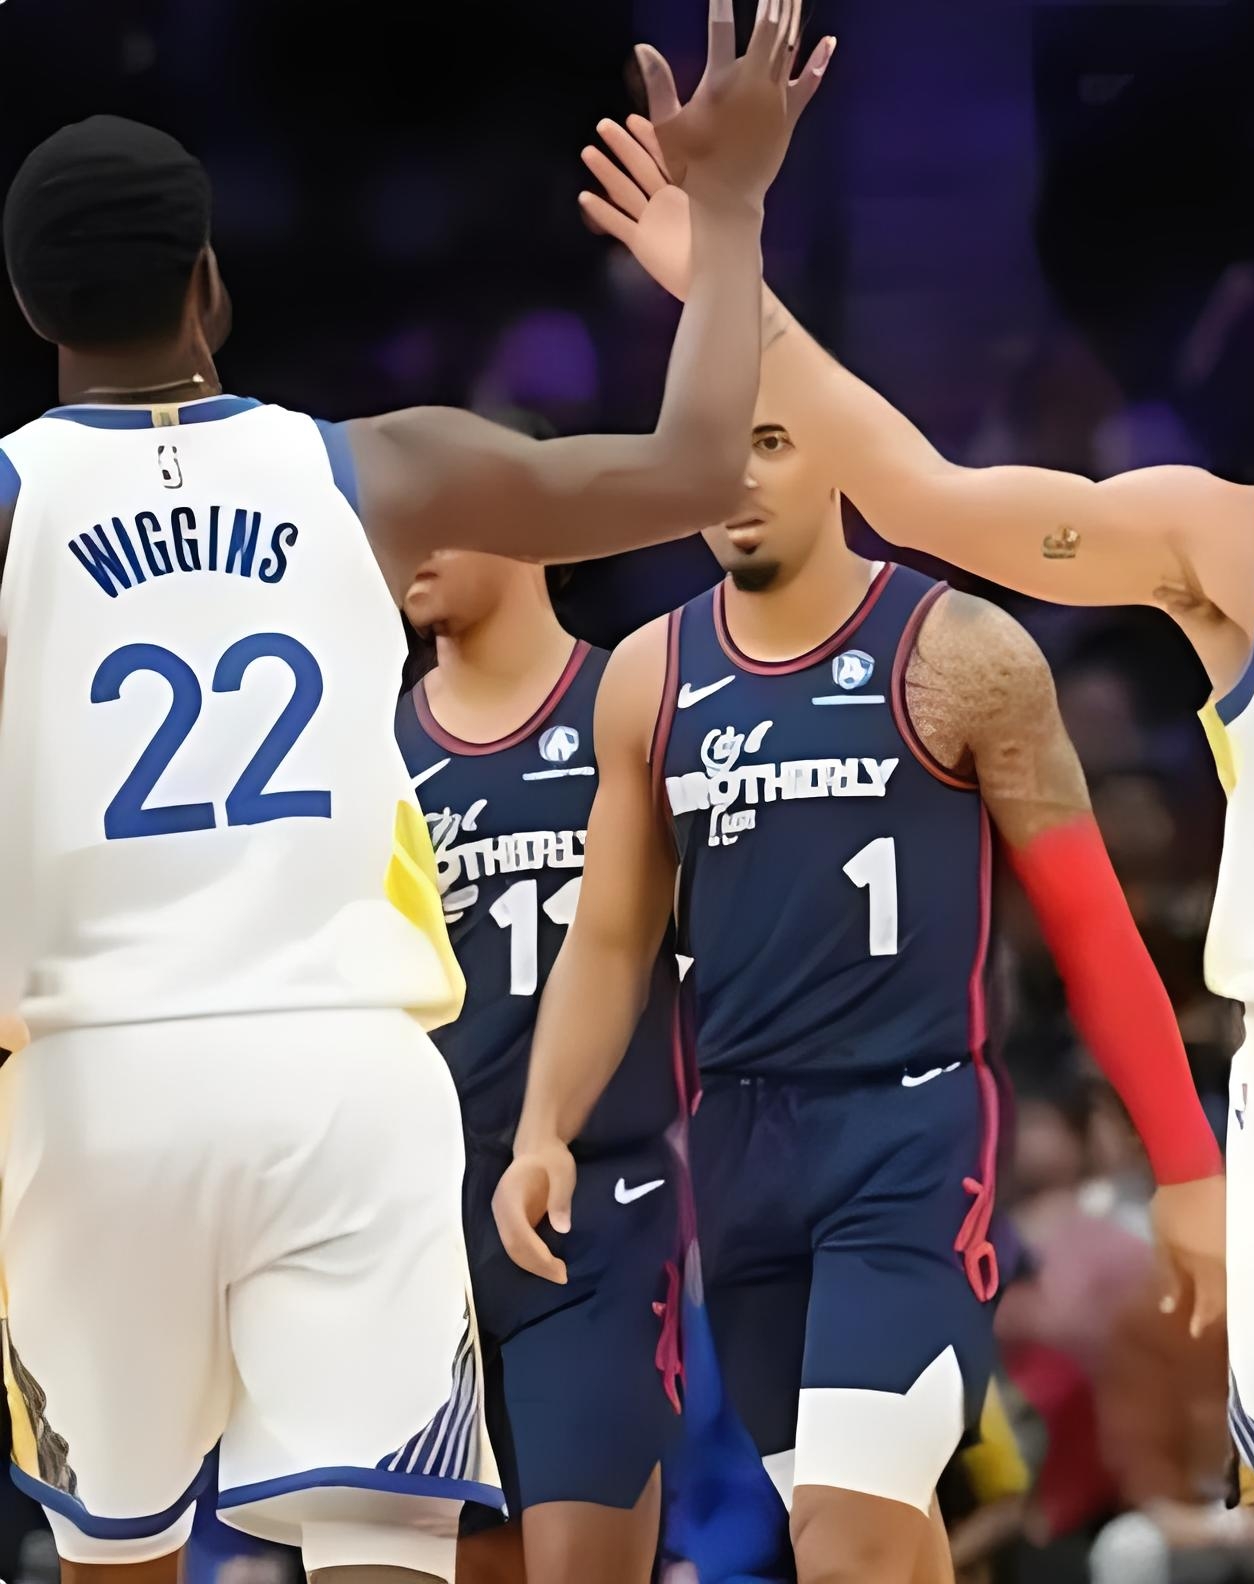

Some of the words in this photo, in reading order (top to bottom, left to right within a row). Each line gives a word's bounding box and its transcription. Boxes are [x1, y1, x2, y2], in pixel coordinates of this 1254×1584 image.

[68, 505, 299, 599] WIGGINS
[90, 632, 332, 840] 22
[842, 836, 898, 957] 1
